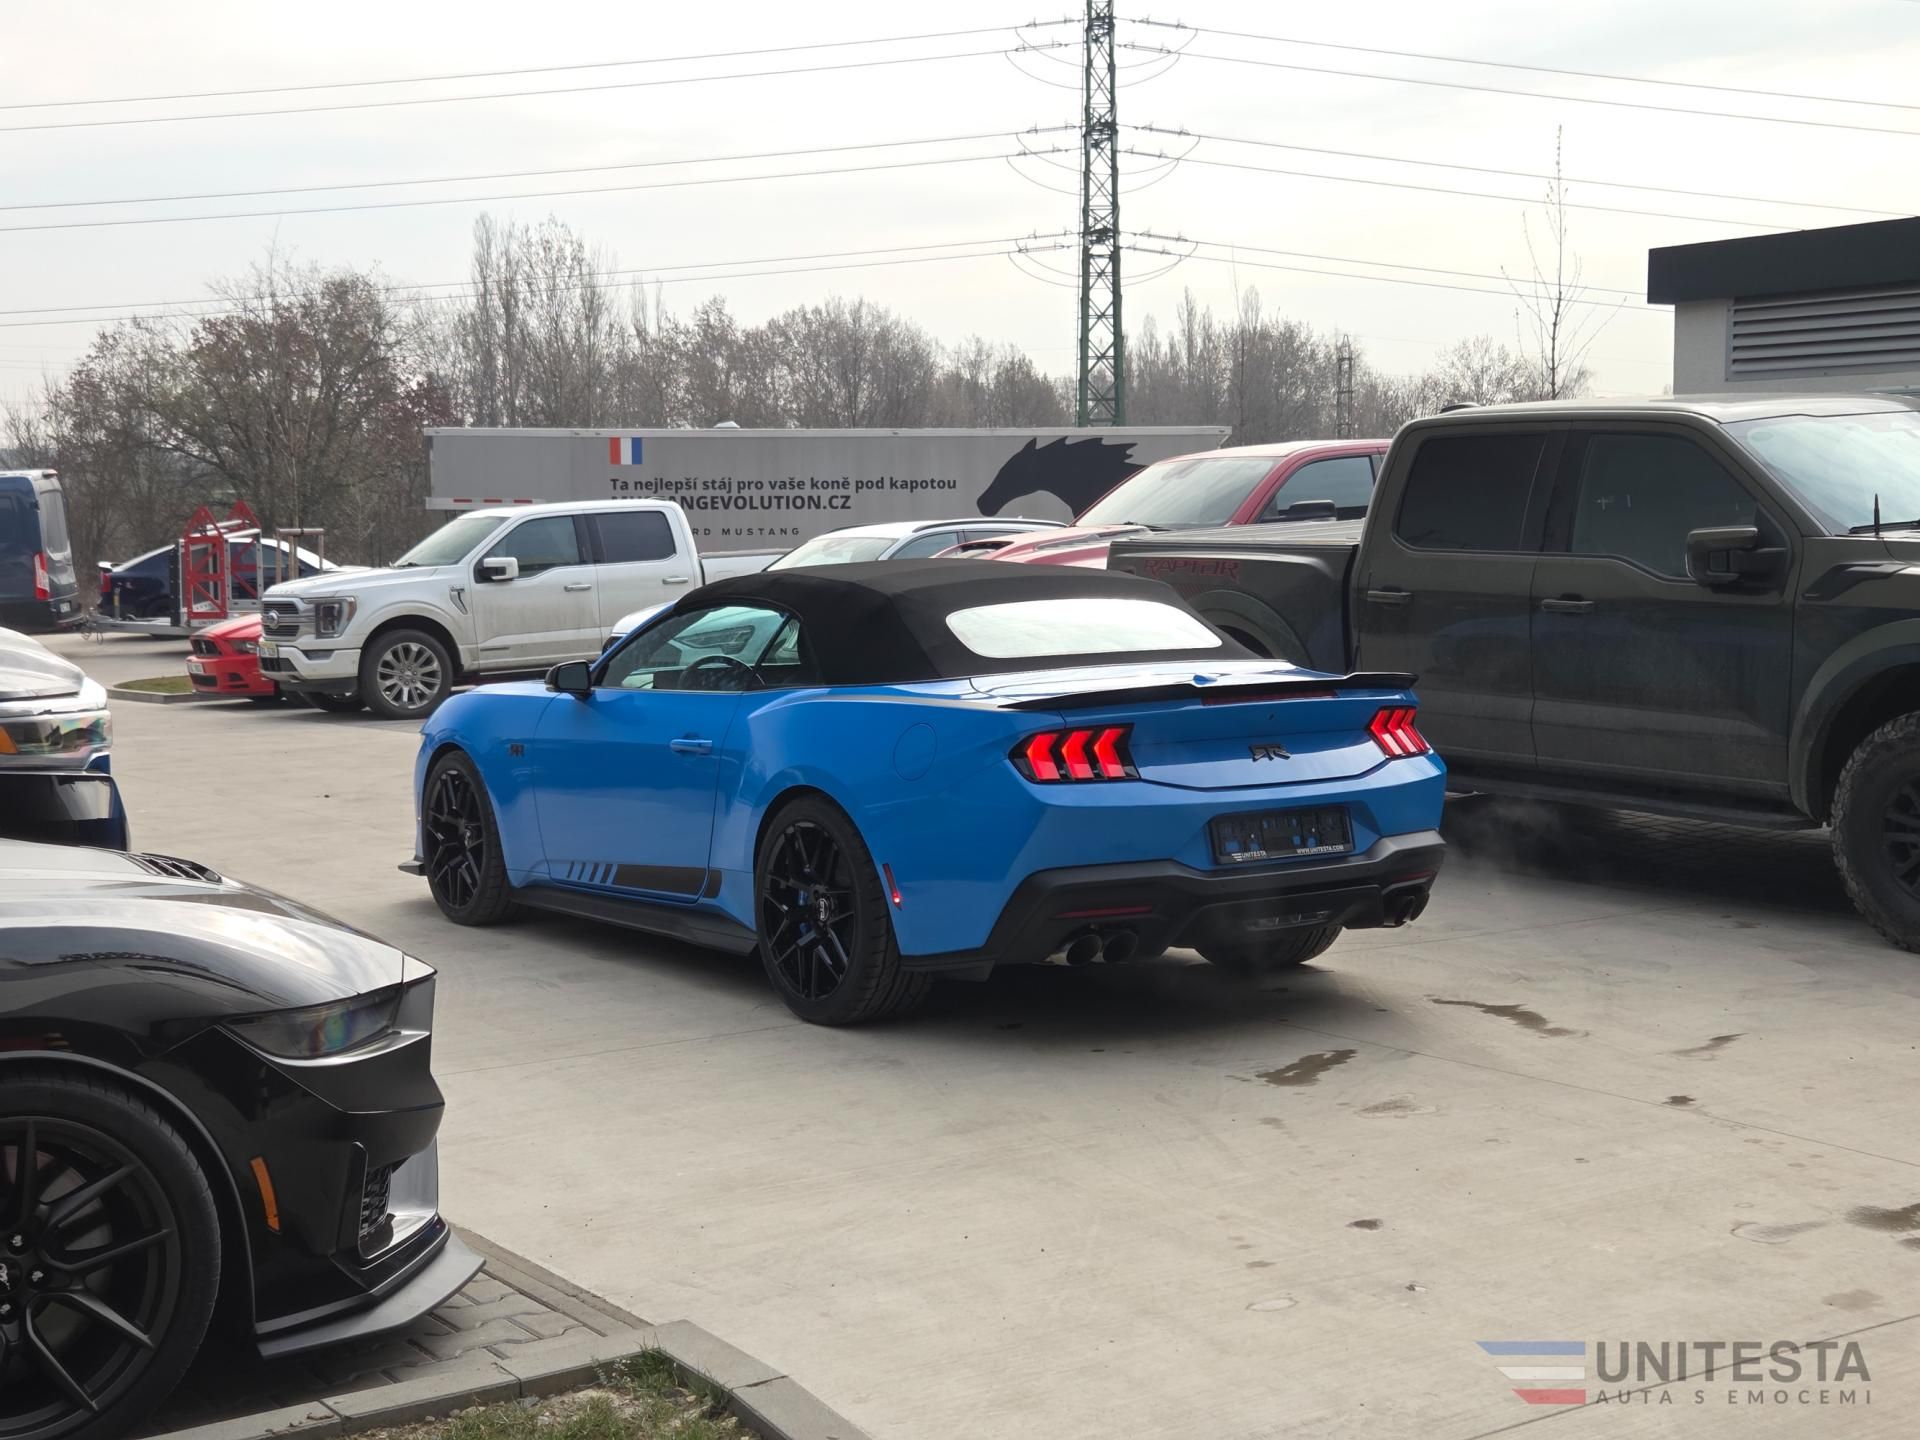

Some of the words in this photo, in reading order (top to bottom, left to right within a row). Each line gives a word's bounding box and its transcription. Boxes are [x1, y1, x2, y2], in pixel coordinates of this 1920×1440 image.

[610, 478, 629, 491] Ta
[634, 477, 698, 494] nejlepší
[702, 477, 732, 494] stáj
[737, 480, 764, 494] pro
[769, 477, 805, 490] vaše
[810, 477, 850, 490] koně
[855, 477, 885, 494] pod
[889, 477, 957, 493] kapotou
[611, 495, 852, 510] NGEVOLUTION.CZ
[692, 528, 711, 536] RD
[722, 528, 799, 536] MUSTANG
[1144, 559, 1240, 581] RAPTOR
